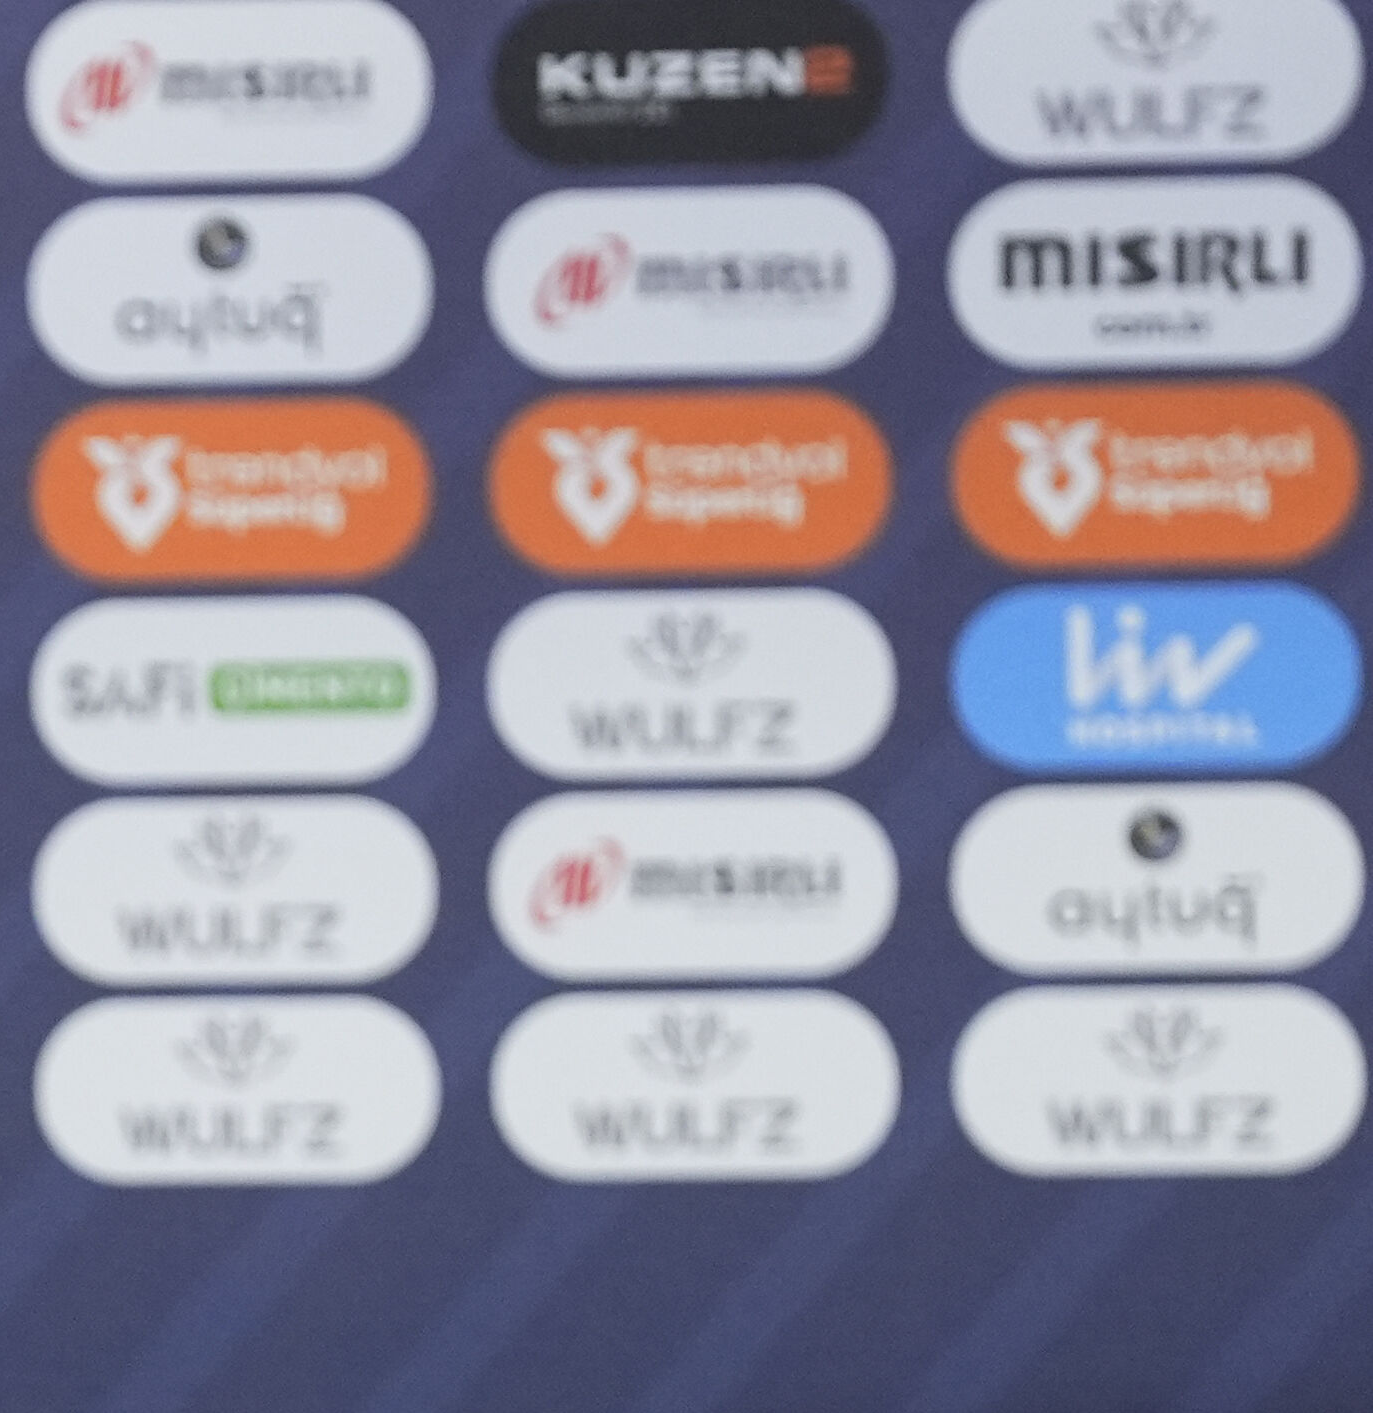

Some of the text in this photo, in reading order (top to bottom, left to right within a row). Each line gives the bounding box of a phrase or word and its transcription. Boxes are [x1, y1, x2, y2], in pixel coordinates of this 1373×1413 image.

[1038, 84, 1266, 141] WULFZ
[570, 700, 799, 757] WULFZ
[117, 903, 341, 960] WULFZ
[118, 1101, 343, 1157] WULFZ
[571, 1096, 801, 1151] WULFZ
[1046, 1094, 1274, 1152] WULFZ
